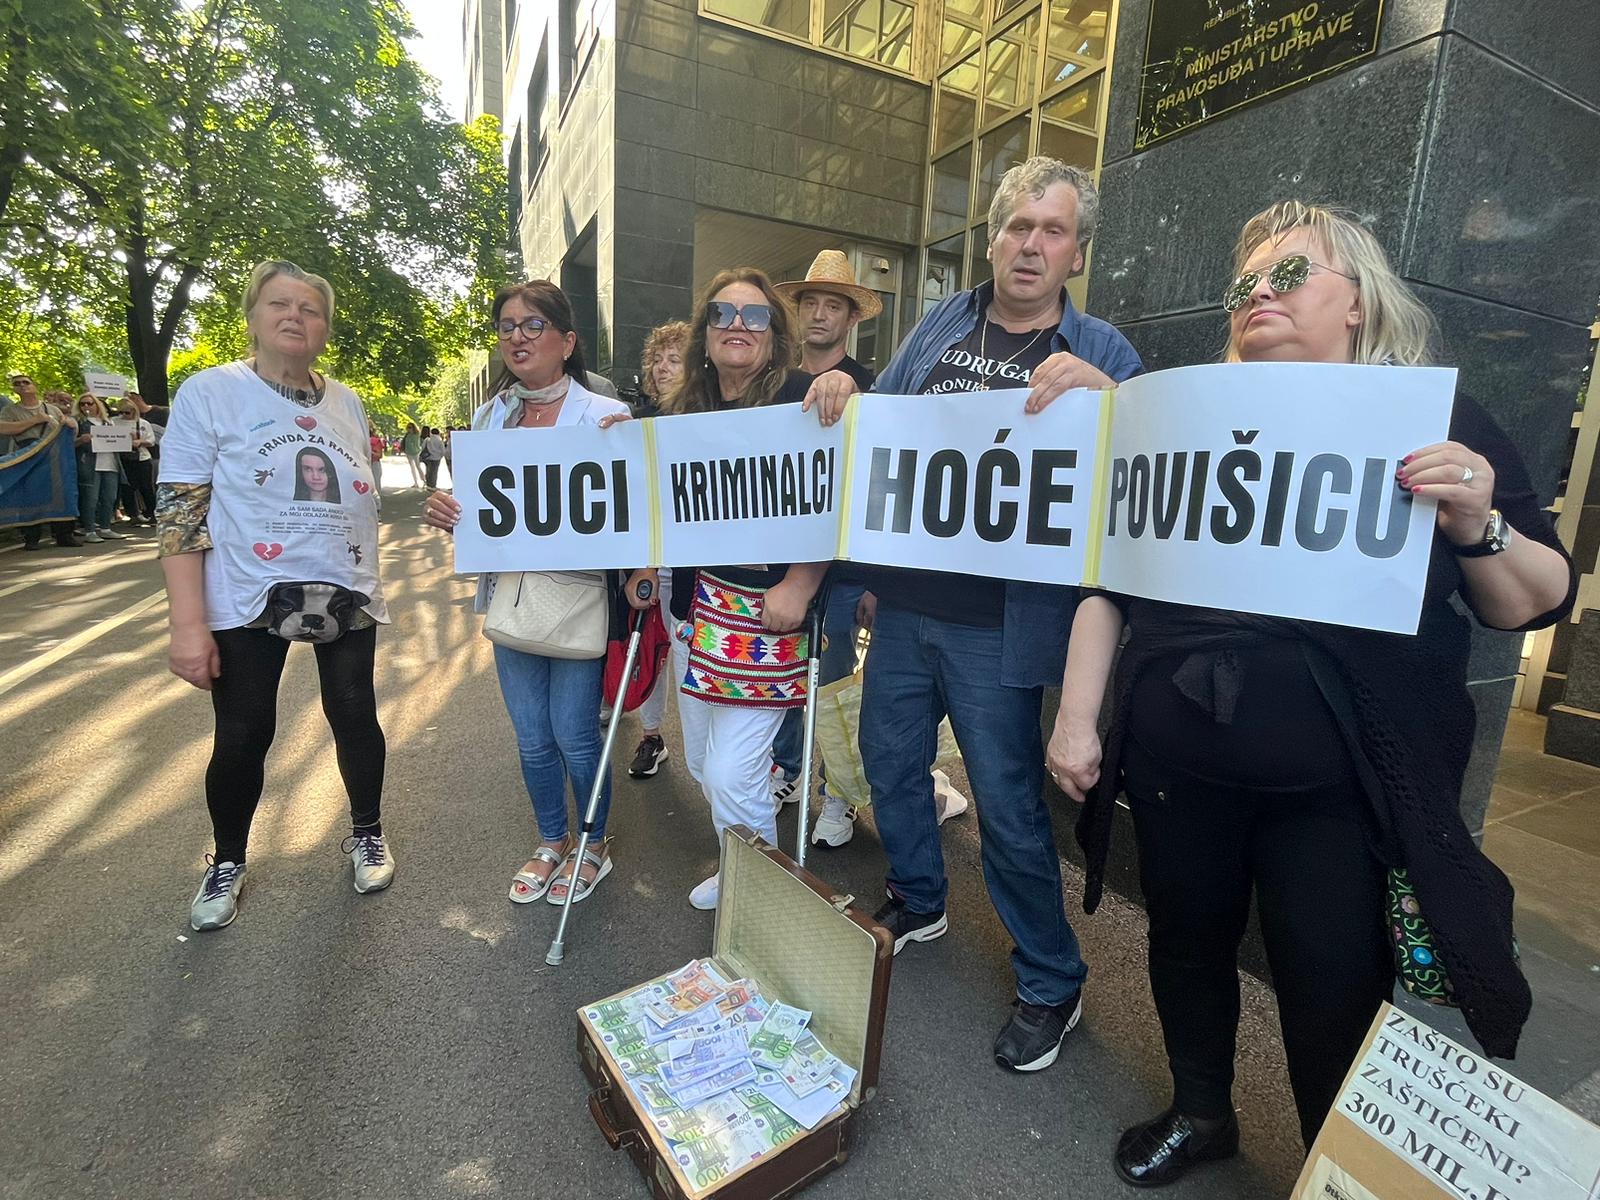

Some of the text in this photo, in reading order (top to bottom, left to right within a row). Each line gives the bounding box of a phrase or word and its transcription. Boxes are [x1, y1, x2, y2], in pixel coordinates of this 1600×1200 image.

[1156, 11, 1355, 114] PRAVOSUĐA I UPRAVE
[1185, 2, 1319, 79] MINISTARSTVO
[941, 349, 1031, 383] UDRUGA
[258, 433, 305, 457] PRAVDA
[308, 434, 325, 446] ZA
[328, 440, 361, 469] RAMY
[477, 428, 1413, 560] SUCI KRIMINALCI HOĆE POVIŠICU
[726, 1013, 743, 1028] 20
[772, 1038, 792, 1059] 100
[1386, 1012, 1527, 1103] ZAŠTO SU
[1345, 1092, 1396, 1136] 300
[1376, 1036, 1523, 1140] TRUŠĆEKI
[1360, 1063, 1532, 1184] ZAŠTIĆENI?
[696, 1166, 725, 1188] 100
